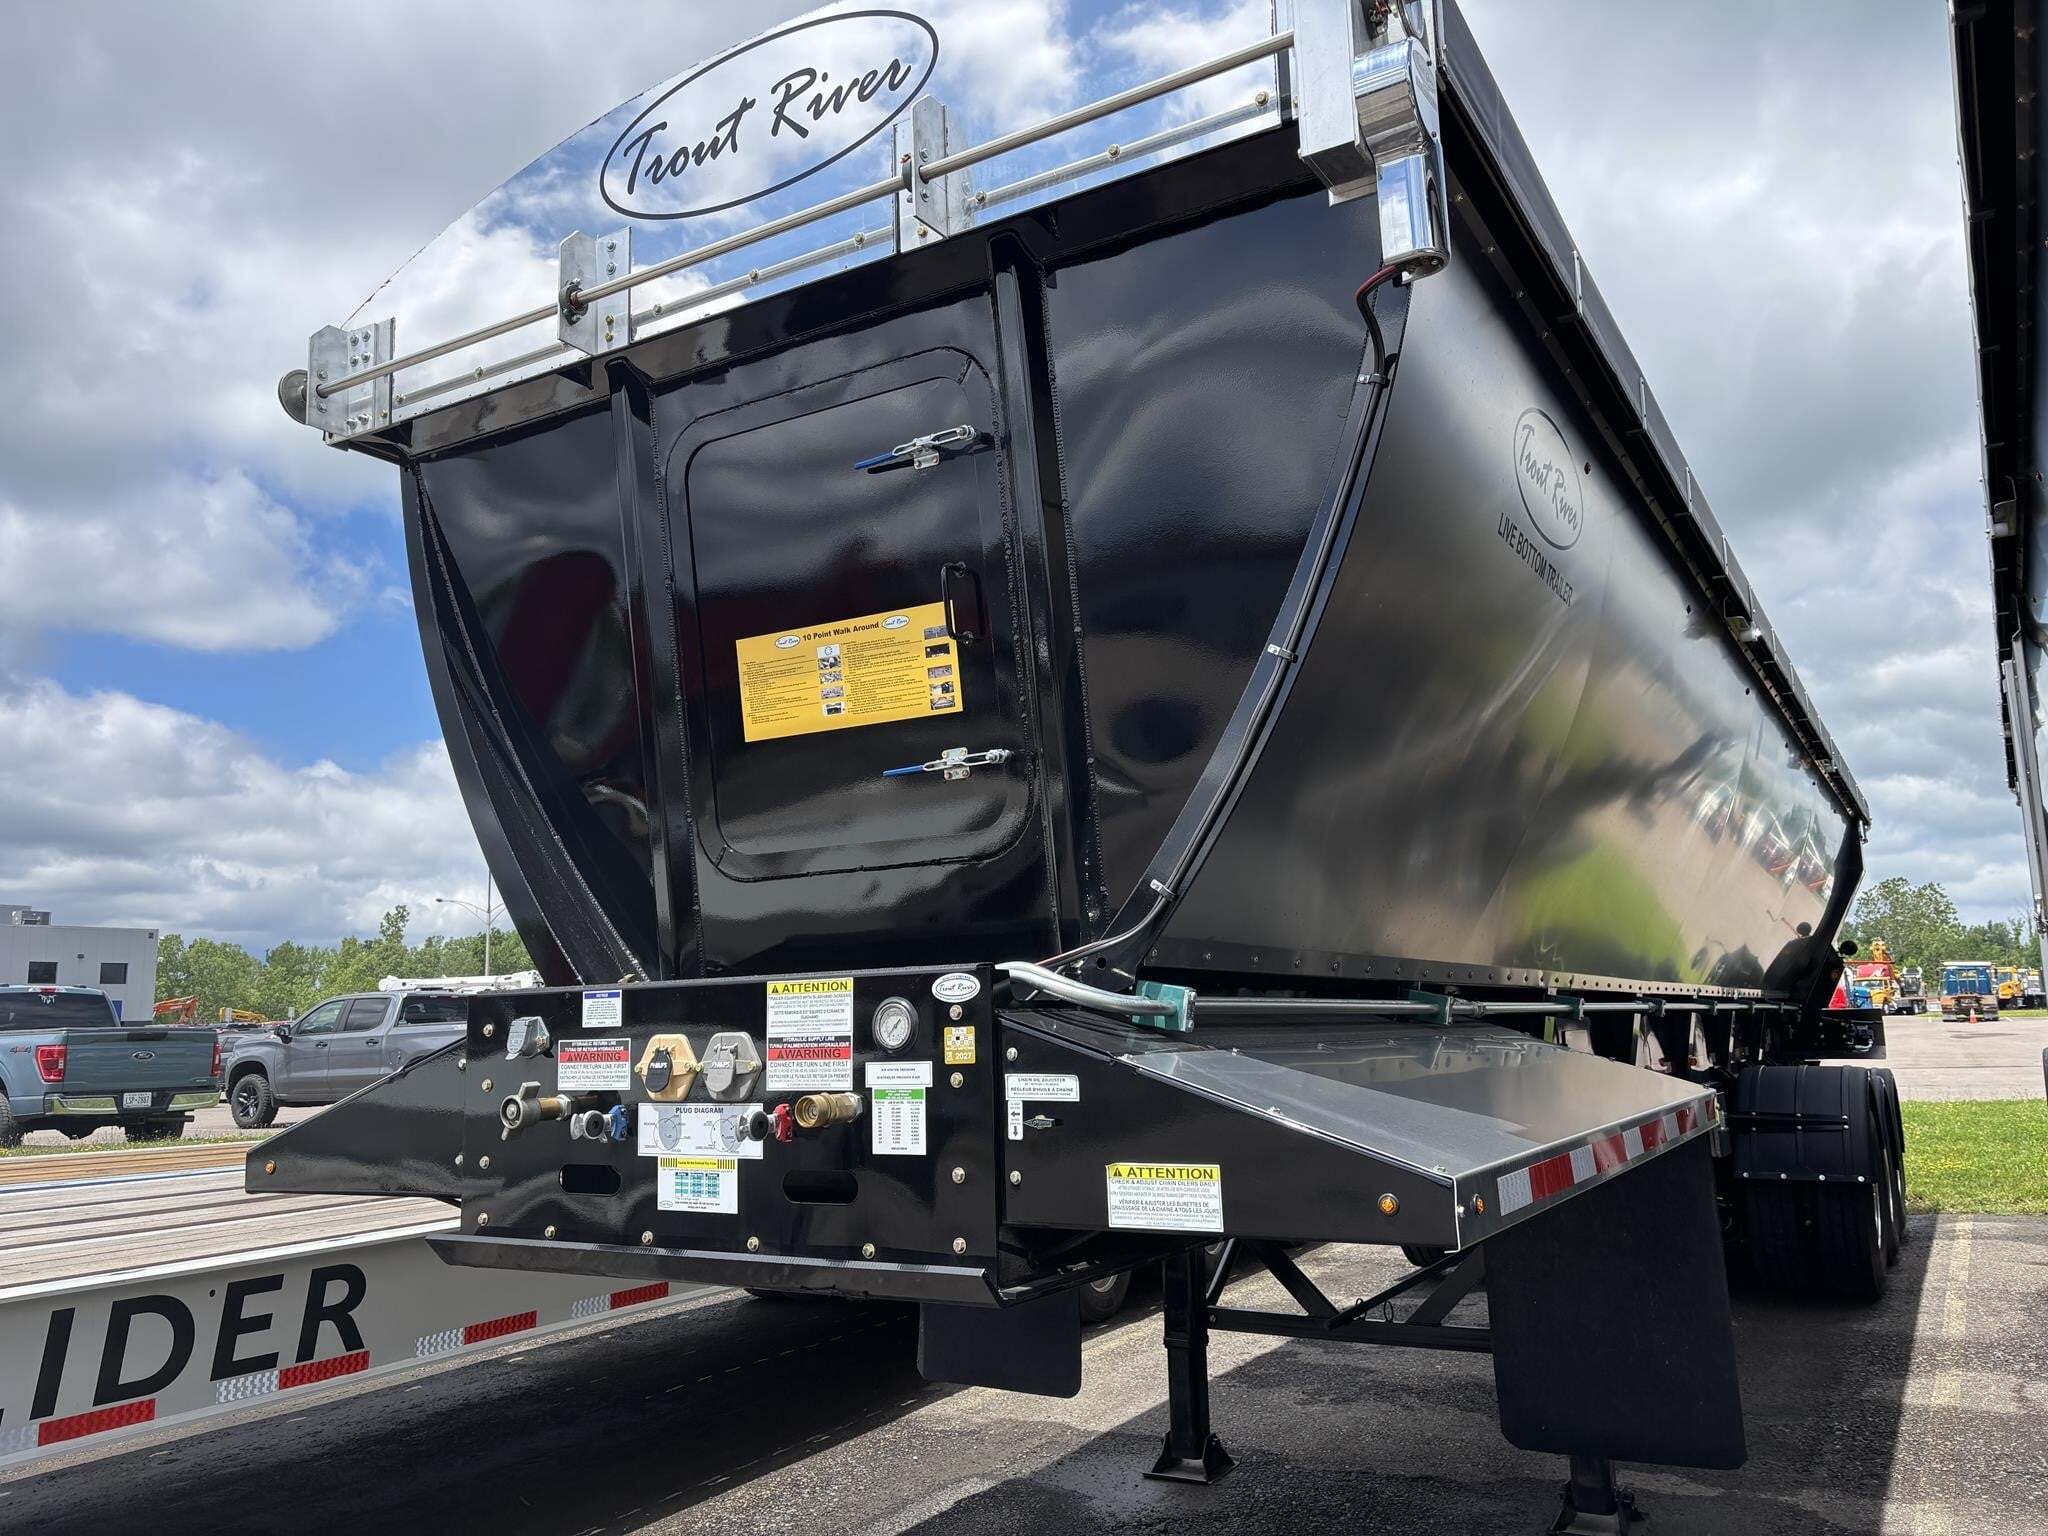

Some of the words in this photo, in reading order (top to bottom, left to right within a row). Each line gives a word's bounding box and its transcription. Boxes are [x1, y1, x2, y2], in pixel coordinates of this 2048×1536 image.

[623, 97, 756, 195] Trout
[770, 58, 912, 139] River
[1520, 423, 1553, 495] Trout
[1552, 467, 1579, 532] River
[1497, 512, 1518, 549] LIVE
[1516, 533, 1548, 581] BOTTOM
[1545, 563, 1574, 608] TRAILER
[813, 630, 832, 640] Point
[833, 627, 851, 636] Walk
[853, 621, 880, 633] Around
[782, 981, 848, 993] ATTENTION
[573, 1052, 621, 1061] WARNING
[785, 1049, 841, 1059] WARNING
[1127, 1167, 1214, 1180] ATTENTION
[0, 1264, 367, 1426] IDER
